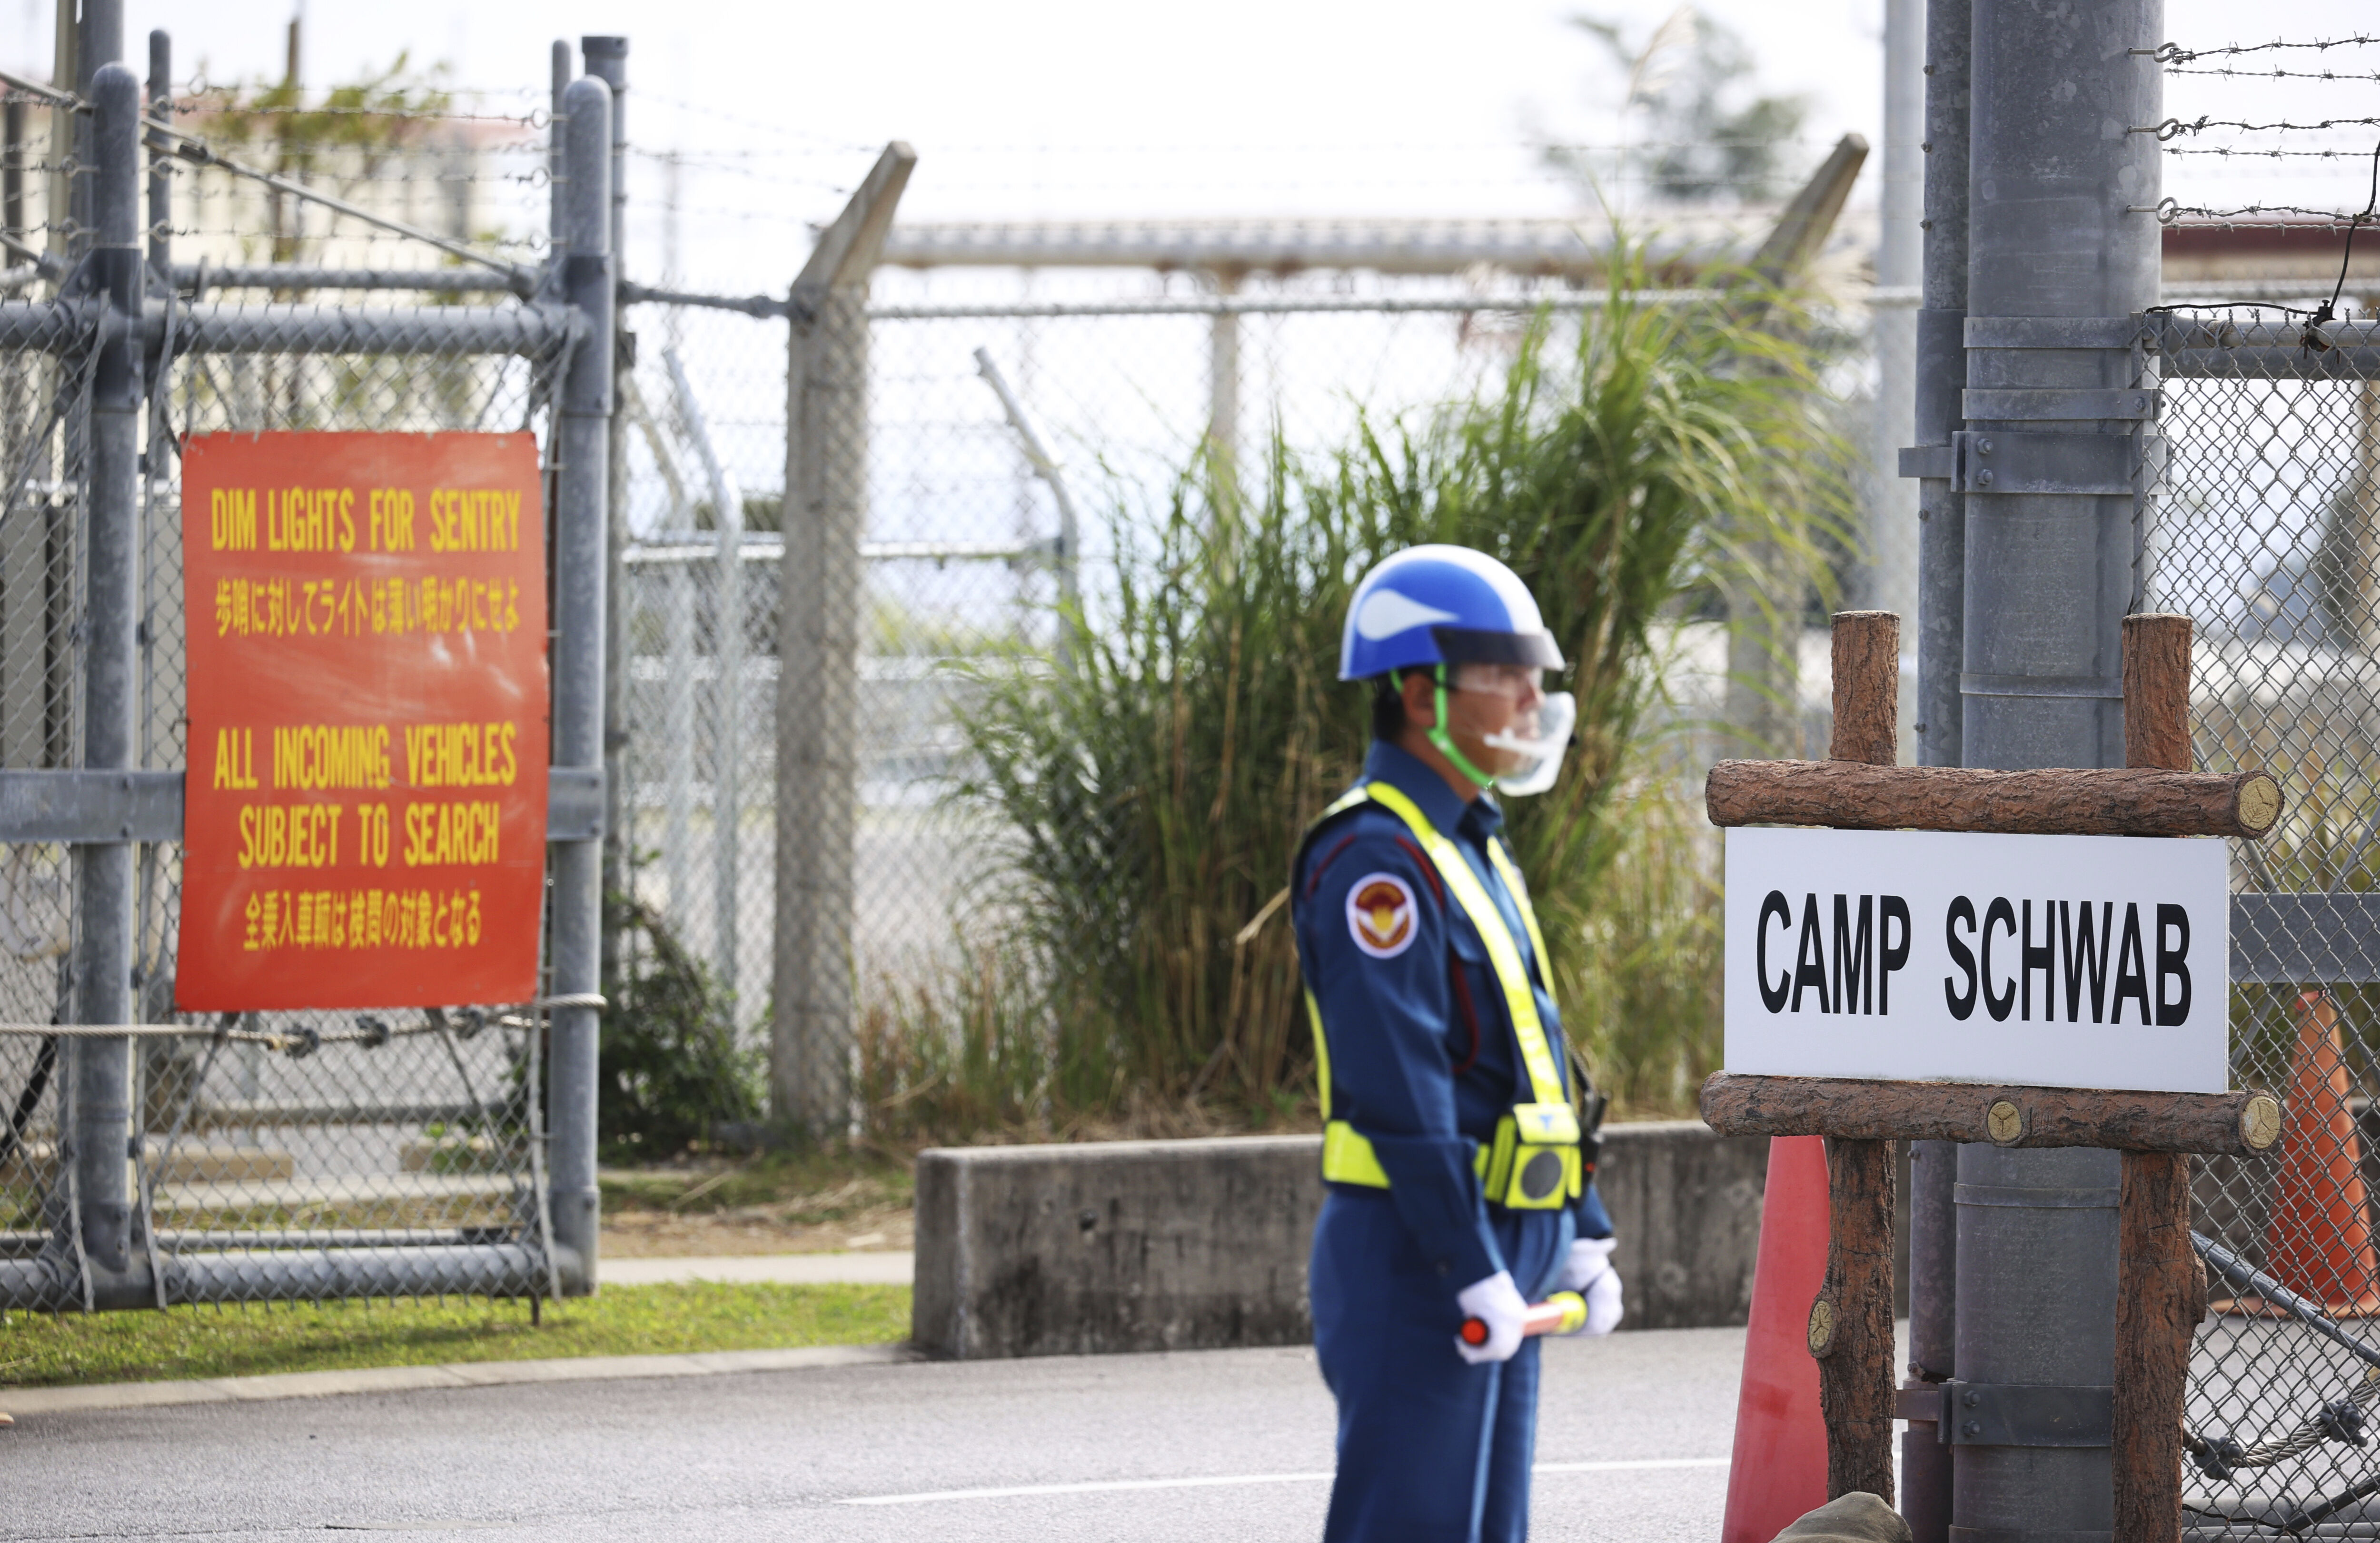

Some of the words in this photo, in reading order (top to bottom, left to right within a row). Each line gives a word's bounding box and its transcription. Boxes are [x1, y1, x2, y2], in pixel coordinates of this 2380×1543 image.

[212, 488, 257, 551] DIM
[268, 486, 356, 553] LIGHTS
[370, 486, 415, 553] FOR
[429, 487, 521, 553] SENTRY
[213, 727, 259, 790] ALL
[274, 724, 390, 790] INCOMING
[405, 721, 517, 788] VEHICLES
[238, 802, 343, 870] SUBJECT
[357, 802, 390, 868] TO
[404, 800, 500, 867] SEARCH
[1756, 890, 1911, 1016] CAMP
[1944, 895, 2192, 1027] SCHWAB
